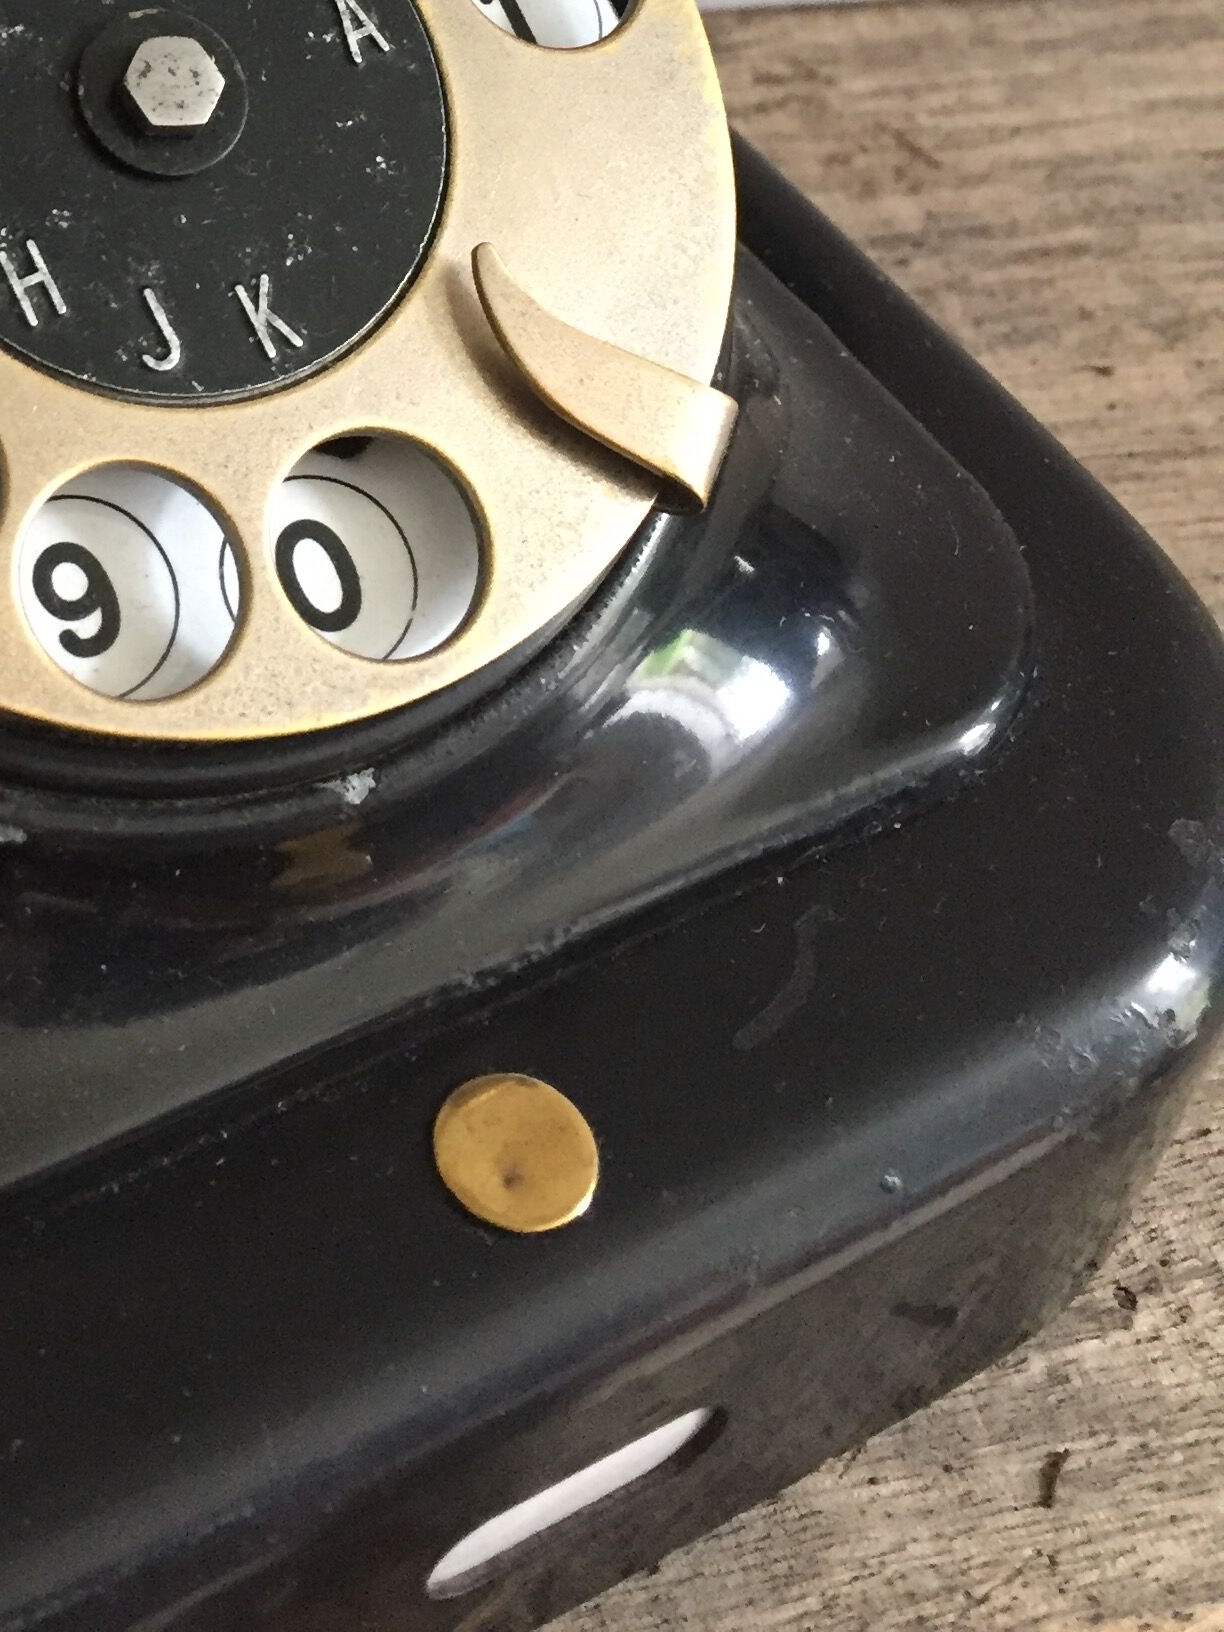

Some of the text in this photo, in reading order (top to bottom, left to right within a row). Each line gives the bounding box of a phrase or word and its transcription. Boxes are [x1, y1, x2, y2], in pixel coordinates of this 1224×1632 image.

[142, 288, 181, 371] J
[235, 274, 304, 359] K
[32, 541, 121, 659] 9
[275, 518, 362, 632] 0
